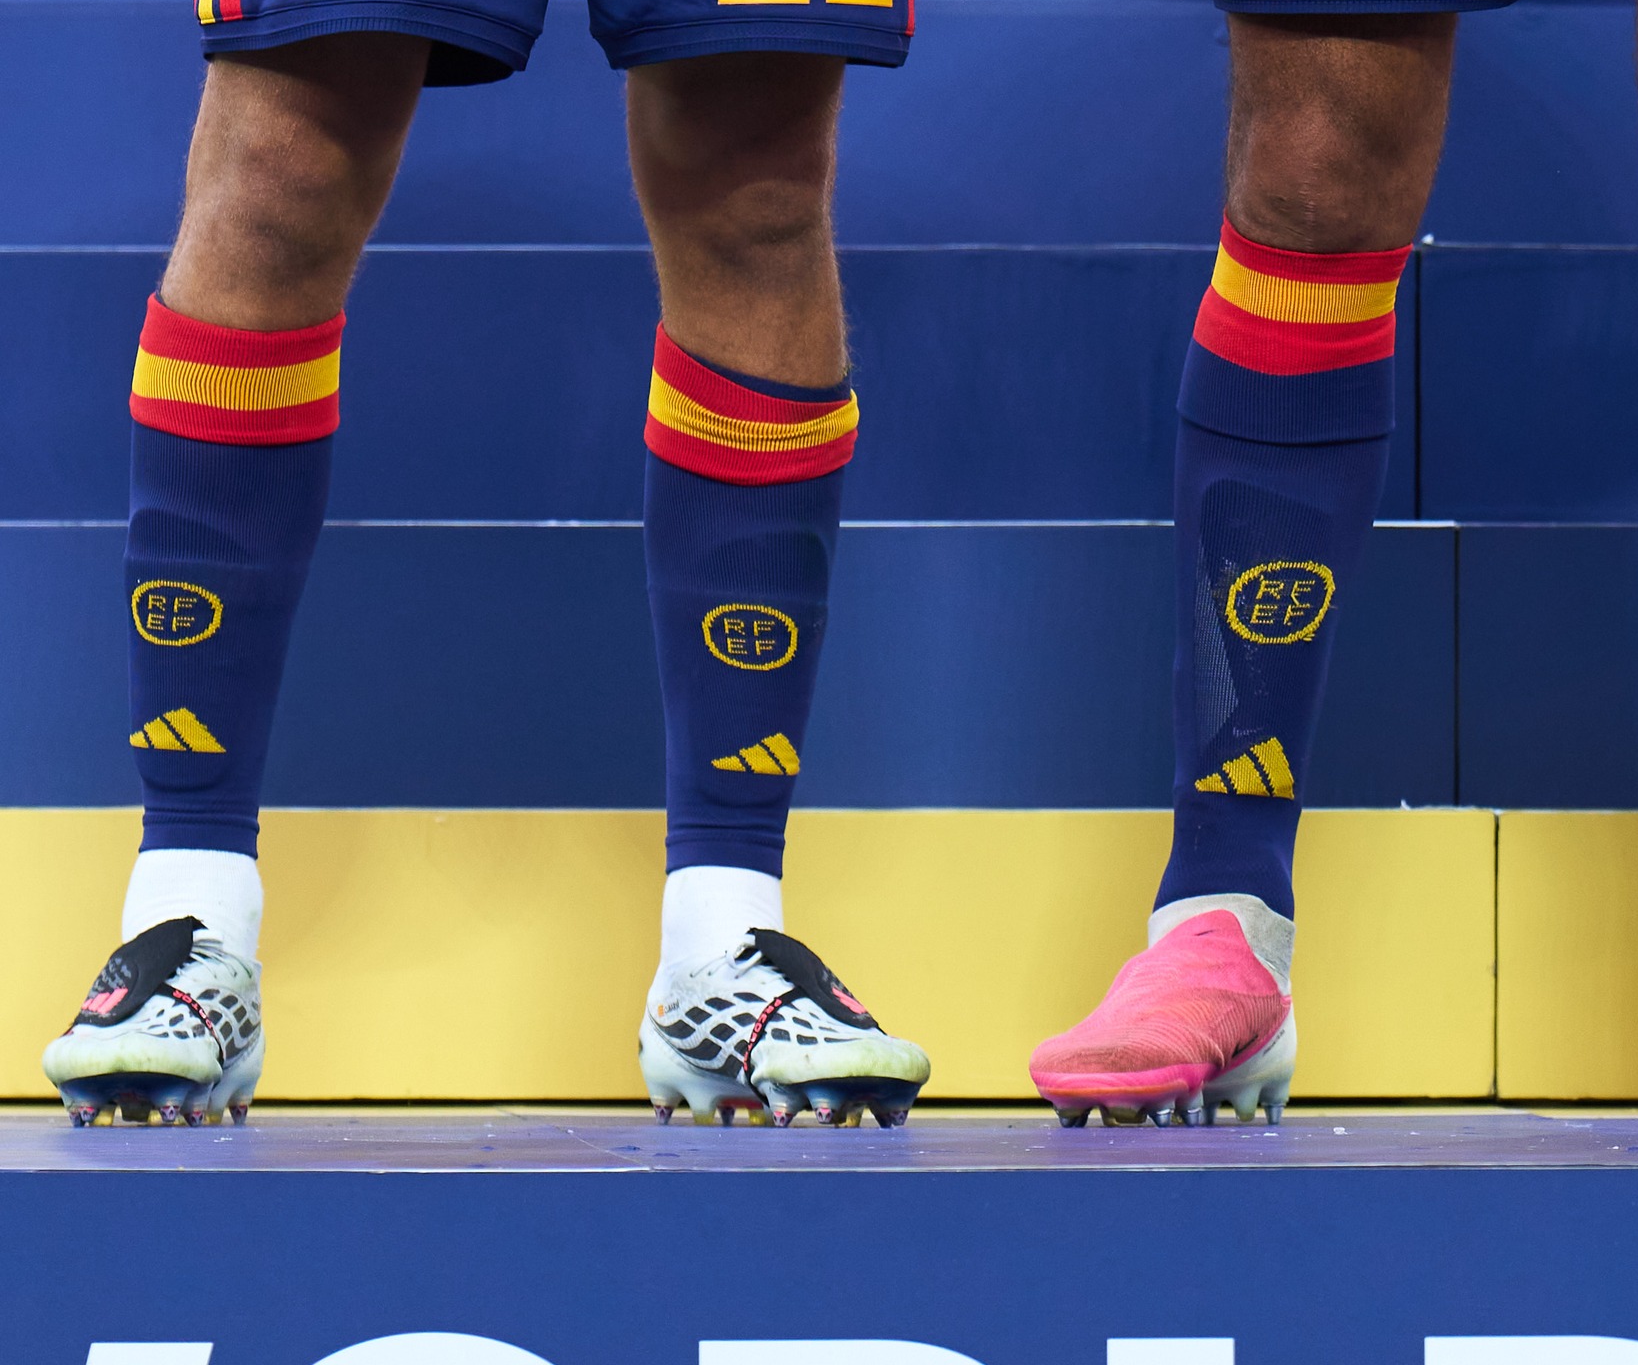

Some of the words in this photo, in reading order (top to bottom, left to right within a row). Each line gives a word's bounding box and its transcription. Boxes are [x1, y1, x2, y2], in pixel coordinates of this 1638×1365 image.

[147, 594, 198, 613] RF
[146, 613, 195, 632] EF
[1250, 603, 1311, 625] EF
[724, 618, 775, 636] RF
[727, 637, 776, 655] EF
